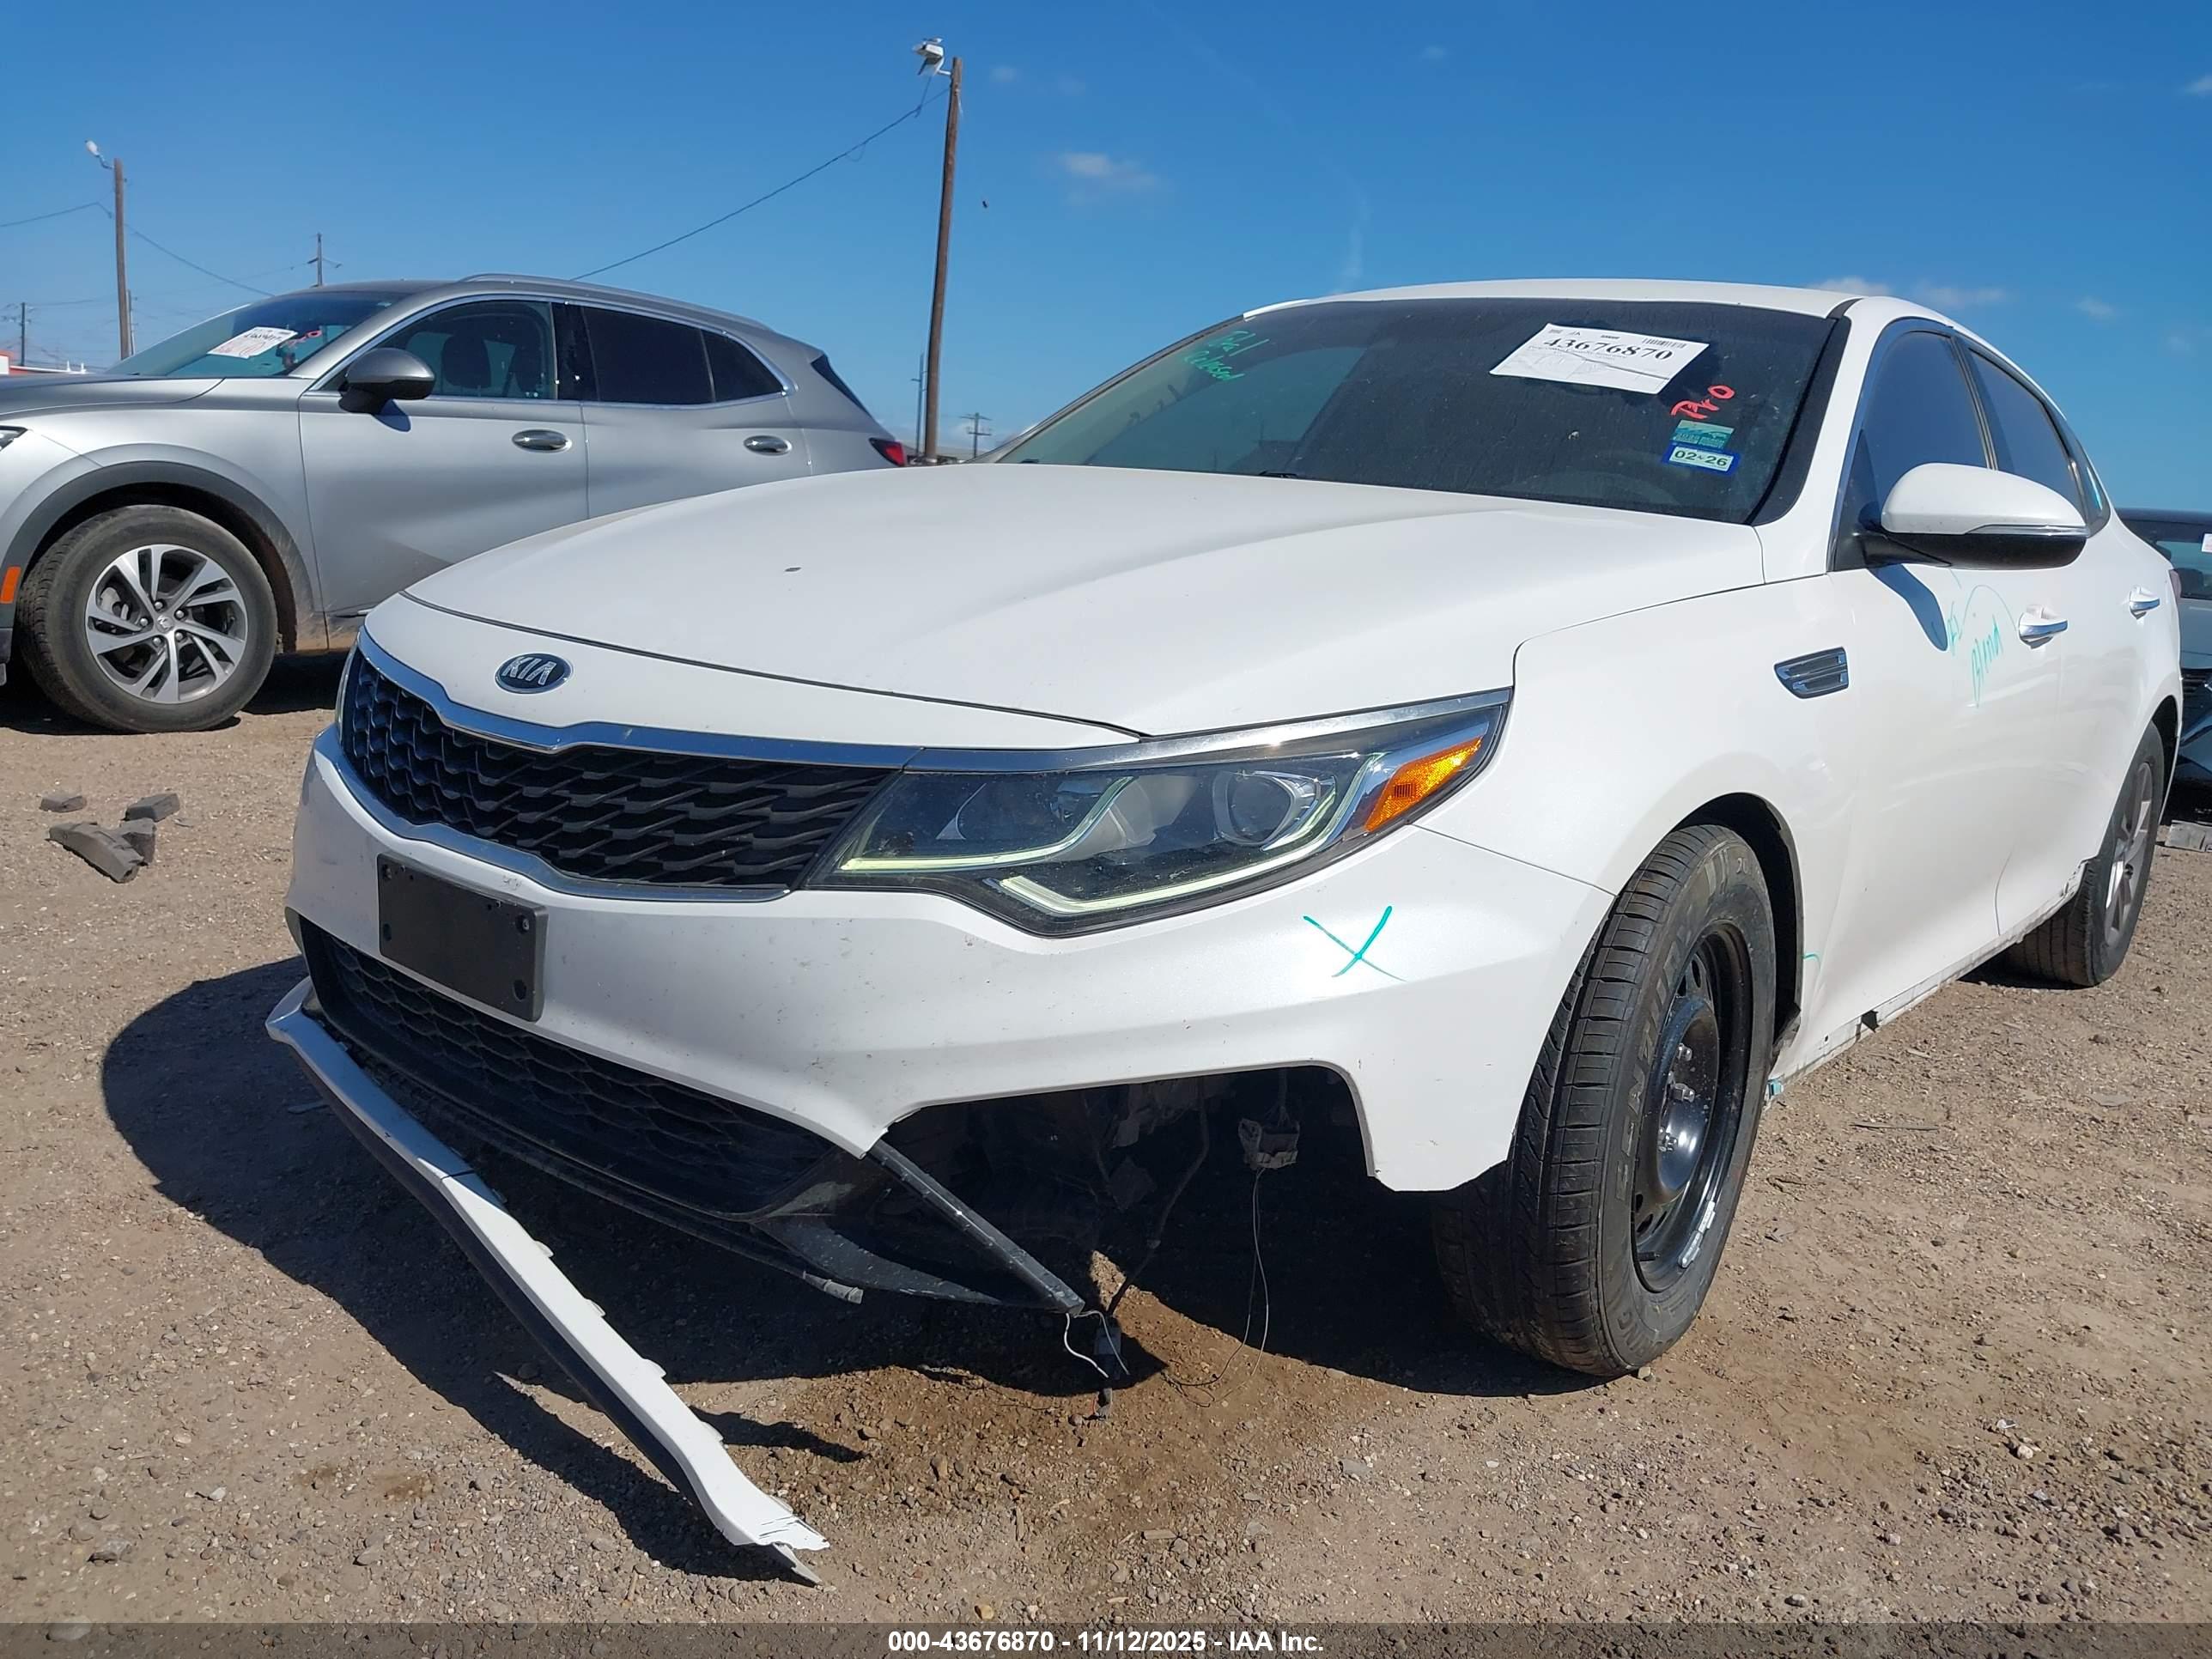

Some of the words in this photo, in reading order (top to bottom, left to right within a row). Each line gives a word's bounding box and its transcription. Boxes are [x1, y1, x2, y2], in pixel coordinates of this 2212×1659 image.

[1543, 336, 1674, 361] 43676870
[1674, 449, 1697, 461] 02
[1704, 454, 1729, 467] 26
[501, 656, 557, 685] KIA
